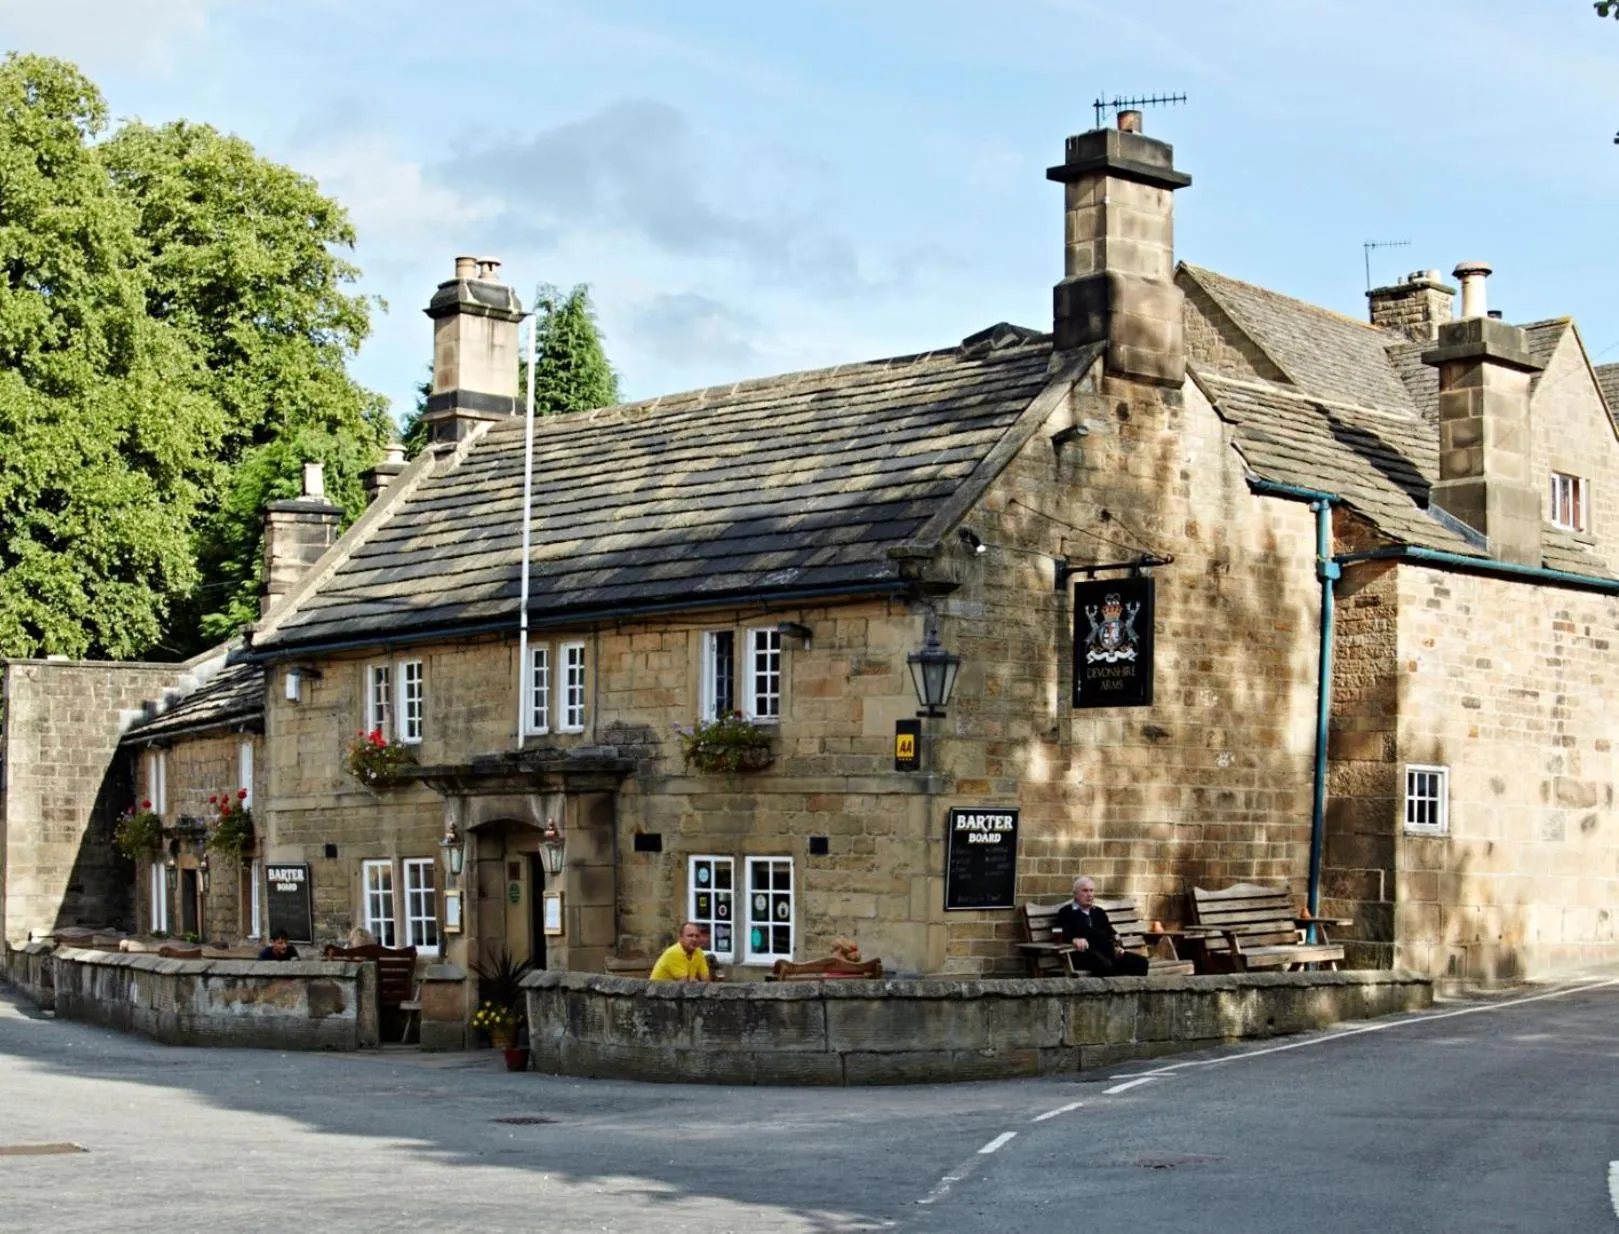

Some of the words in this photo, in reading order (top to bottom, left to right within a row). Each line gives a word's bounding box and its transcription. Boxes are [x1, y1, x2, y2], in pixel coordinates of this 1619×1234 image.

[1087, 666, 1136, 679] DEVONSHIRE
[900, 740, 912, 753] AA
[957, 815, 1013, 832] BARTER
[968, 833, 1001, 843] BOARD
[268, 869, 304, 882] BARTER
